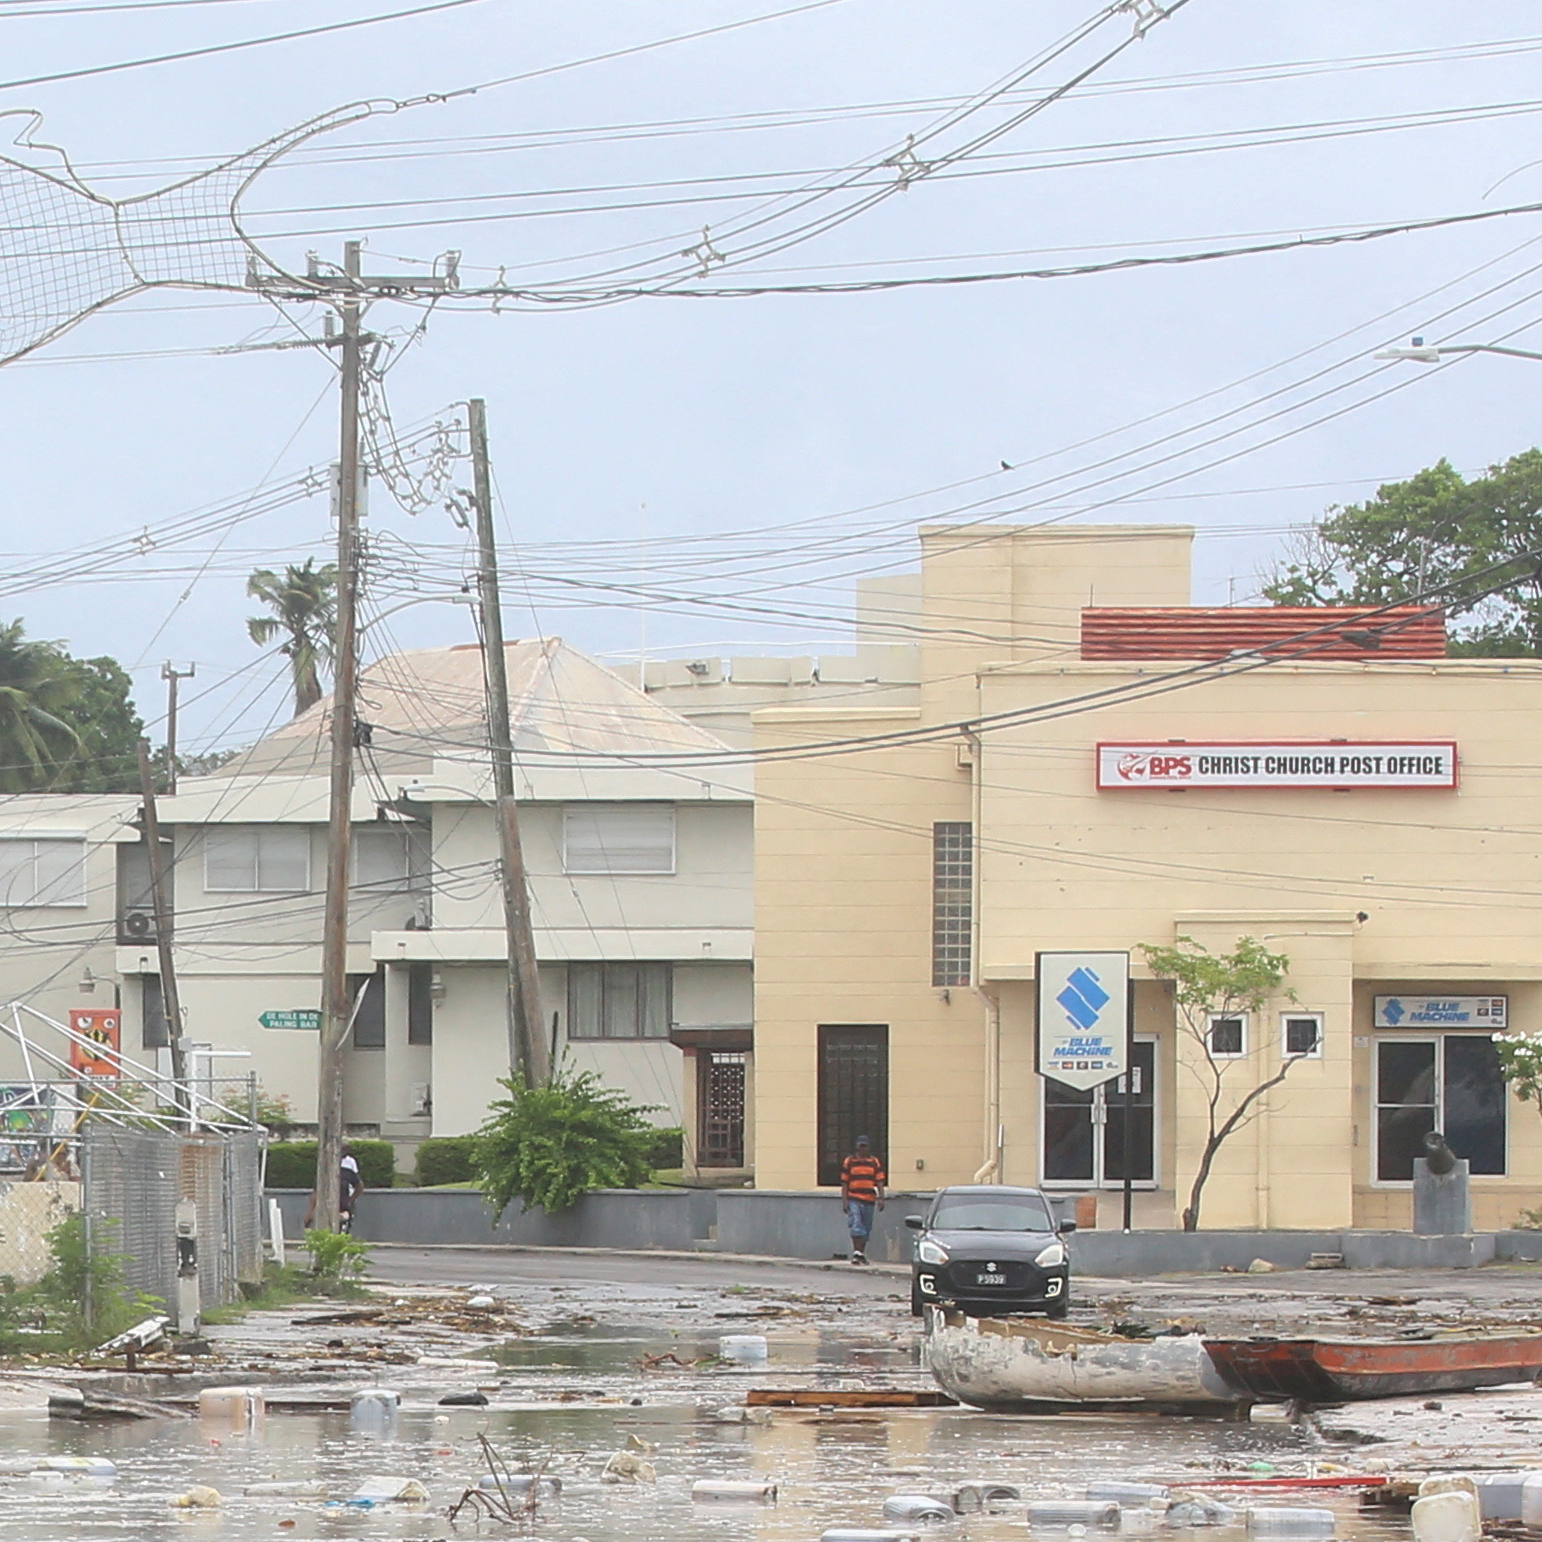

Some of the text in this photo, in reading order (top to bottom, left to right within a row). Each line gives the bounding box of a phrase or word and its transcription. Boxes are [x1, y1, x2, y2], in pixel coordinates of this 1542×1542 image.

[1150, 755, 1443, 776] BPS CHRIST CHURCH POST OFFICE
[1425, 1003, 1461, 1011] BLUE
[1409, 1012, 1470, 1021] MACHINE
[1069, 1038, 1102, 1047] BLUE
[1053, 1047, 1113, 1056] MACHINE
